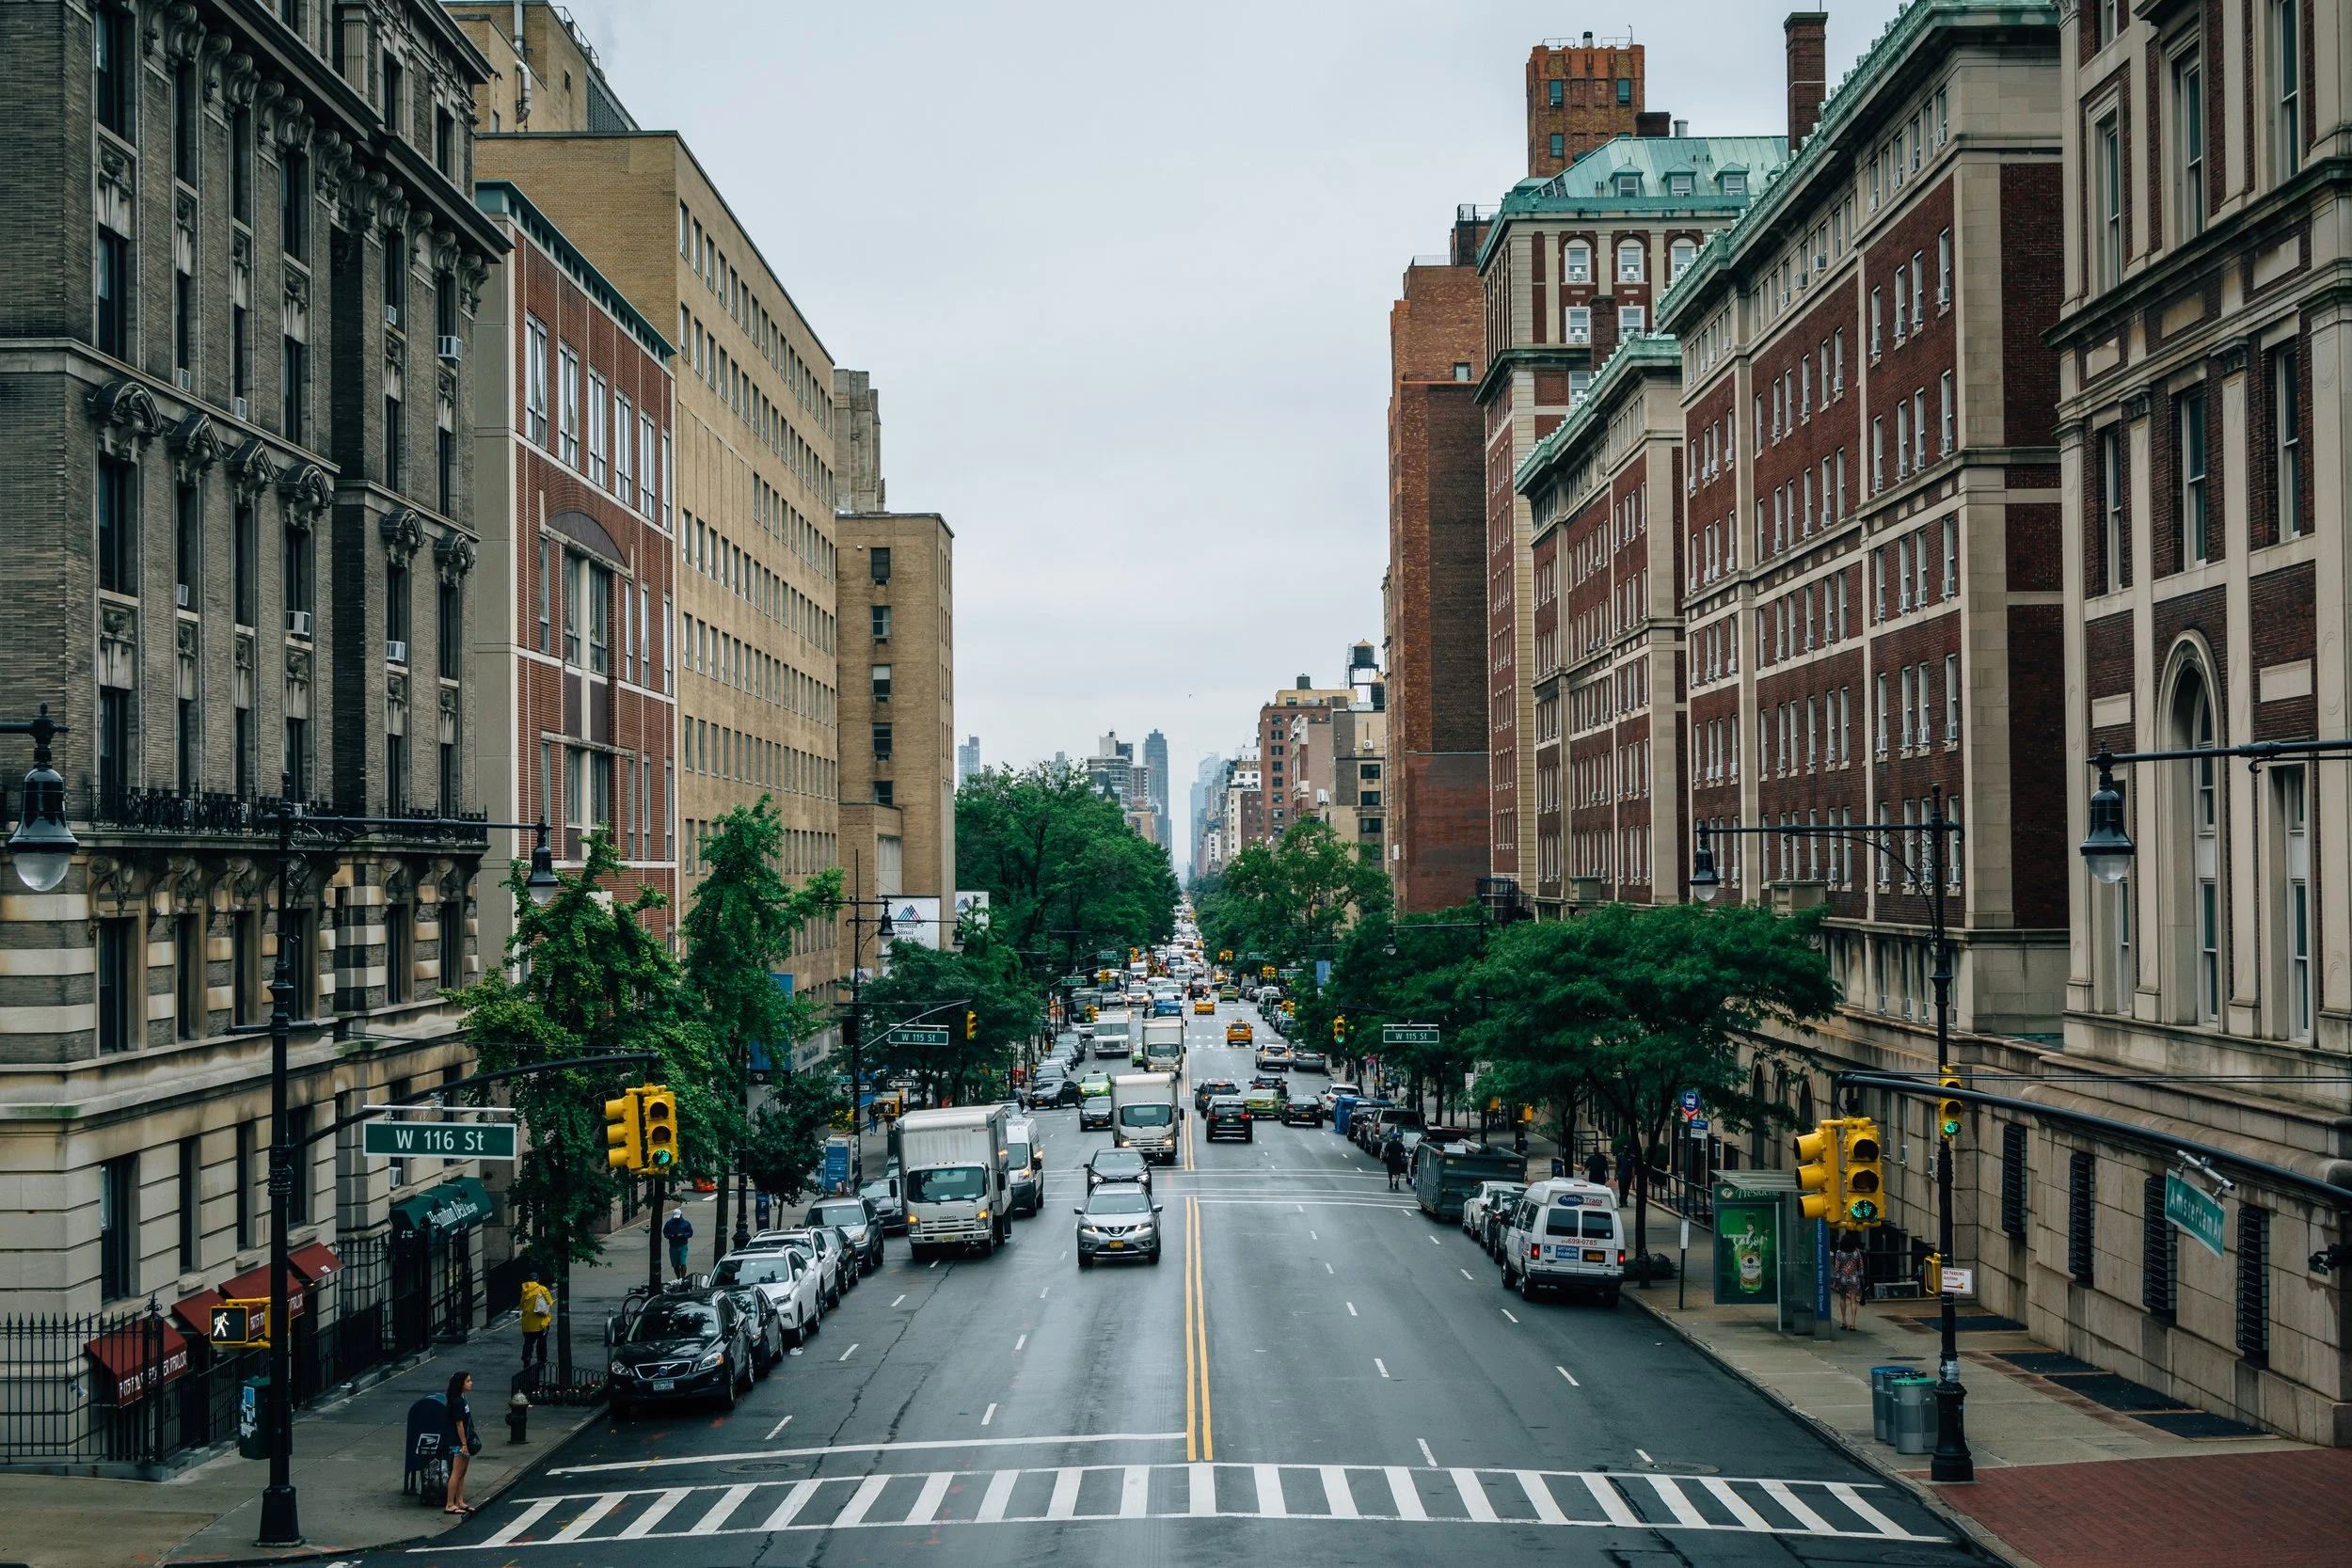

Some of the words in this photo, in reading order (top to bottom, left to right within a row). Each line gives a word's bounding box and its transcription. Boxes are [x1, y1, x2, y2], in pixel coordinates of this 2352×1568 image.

[901, 1033, 910, 1041] W
[913, 1034, 925, 1042] 115
[927, 1034, 936, 1042] St
[395, 1129, 414, 1149] W
[423, 1130, 454, 1150] 116
[464, 1131, 485, 1151] St
[2169, 1185, 2214, 1237] Amsterdam
[2213, 1214, 2222, 1243] Av
[1567, 1238, 1597, 1246] 699-0785
